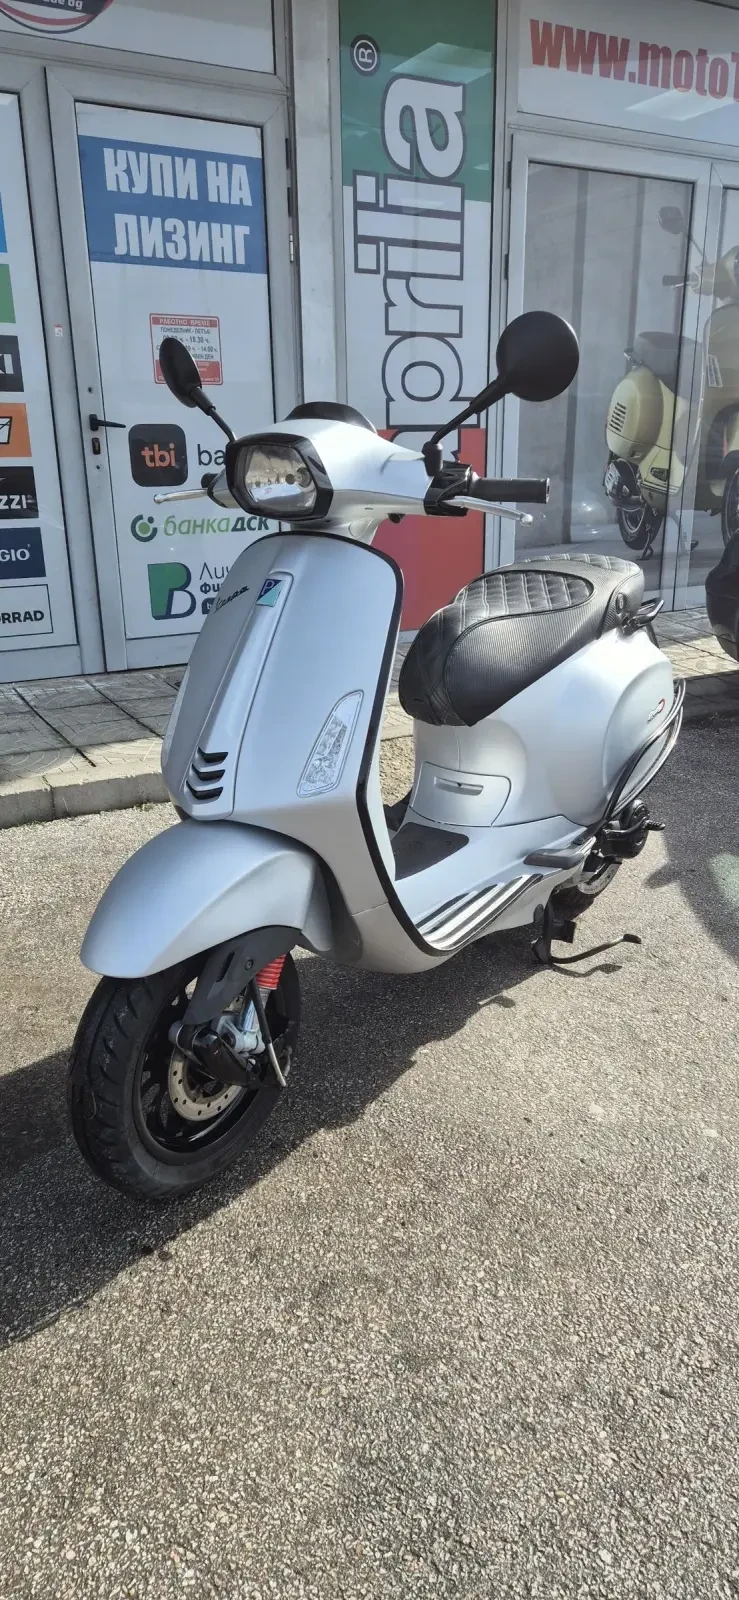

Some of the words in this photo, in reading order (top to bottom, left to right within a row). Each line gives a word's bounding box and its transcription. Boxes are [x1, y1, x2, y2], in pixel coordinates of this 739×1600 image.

[103, 147, 198, 200] КУПИ
[206, 160, 252, 206] НА
[114, 213, 250, 265] ЛИЗИНГ
[141, 443, 176, 468] tbi
[0, 610, 44, 624] RRAD
